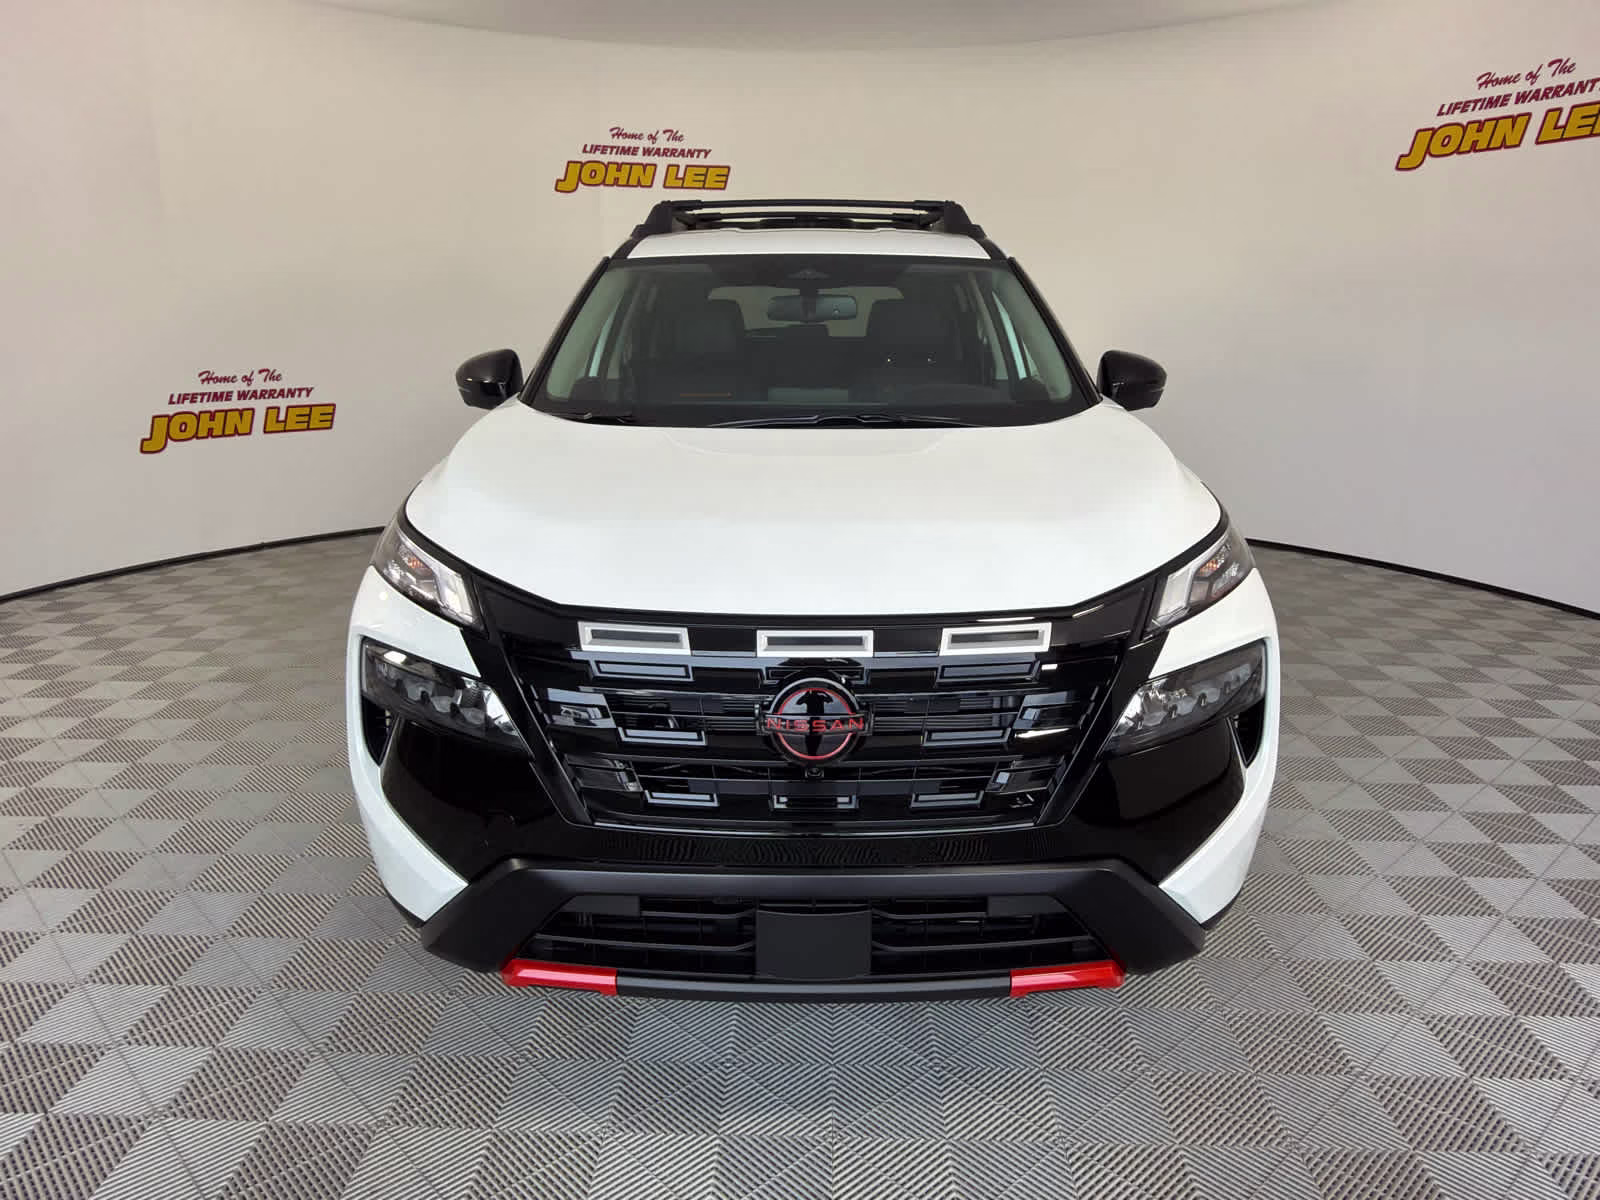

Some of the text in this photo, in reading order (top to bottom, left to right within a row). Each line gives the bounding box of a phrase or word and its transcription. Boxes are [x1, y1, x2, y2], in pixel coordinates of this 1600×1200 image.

[1476, 57, 1576, 90] Home of The
[1437, 77, 1600, 116] LIFETIME WARRANT
[609, 127, 684, 144] Home of The
[1395, 100, 1600, 171] JOHN LE
[582, 144, 712, 158] LIFETIME WARRANTY
[555, 161, 730, 193] JOHN LEE
[198, 368, 282, 386] Home of The
[168, 387, 314, 405] LIFETIME WARRANTY
[140, 403, 336, 454] JOHN LEE
[766, 717, 865, 732] NISSAN
